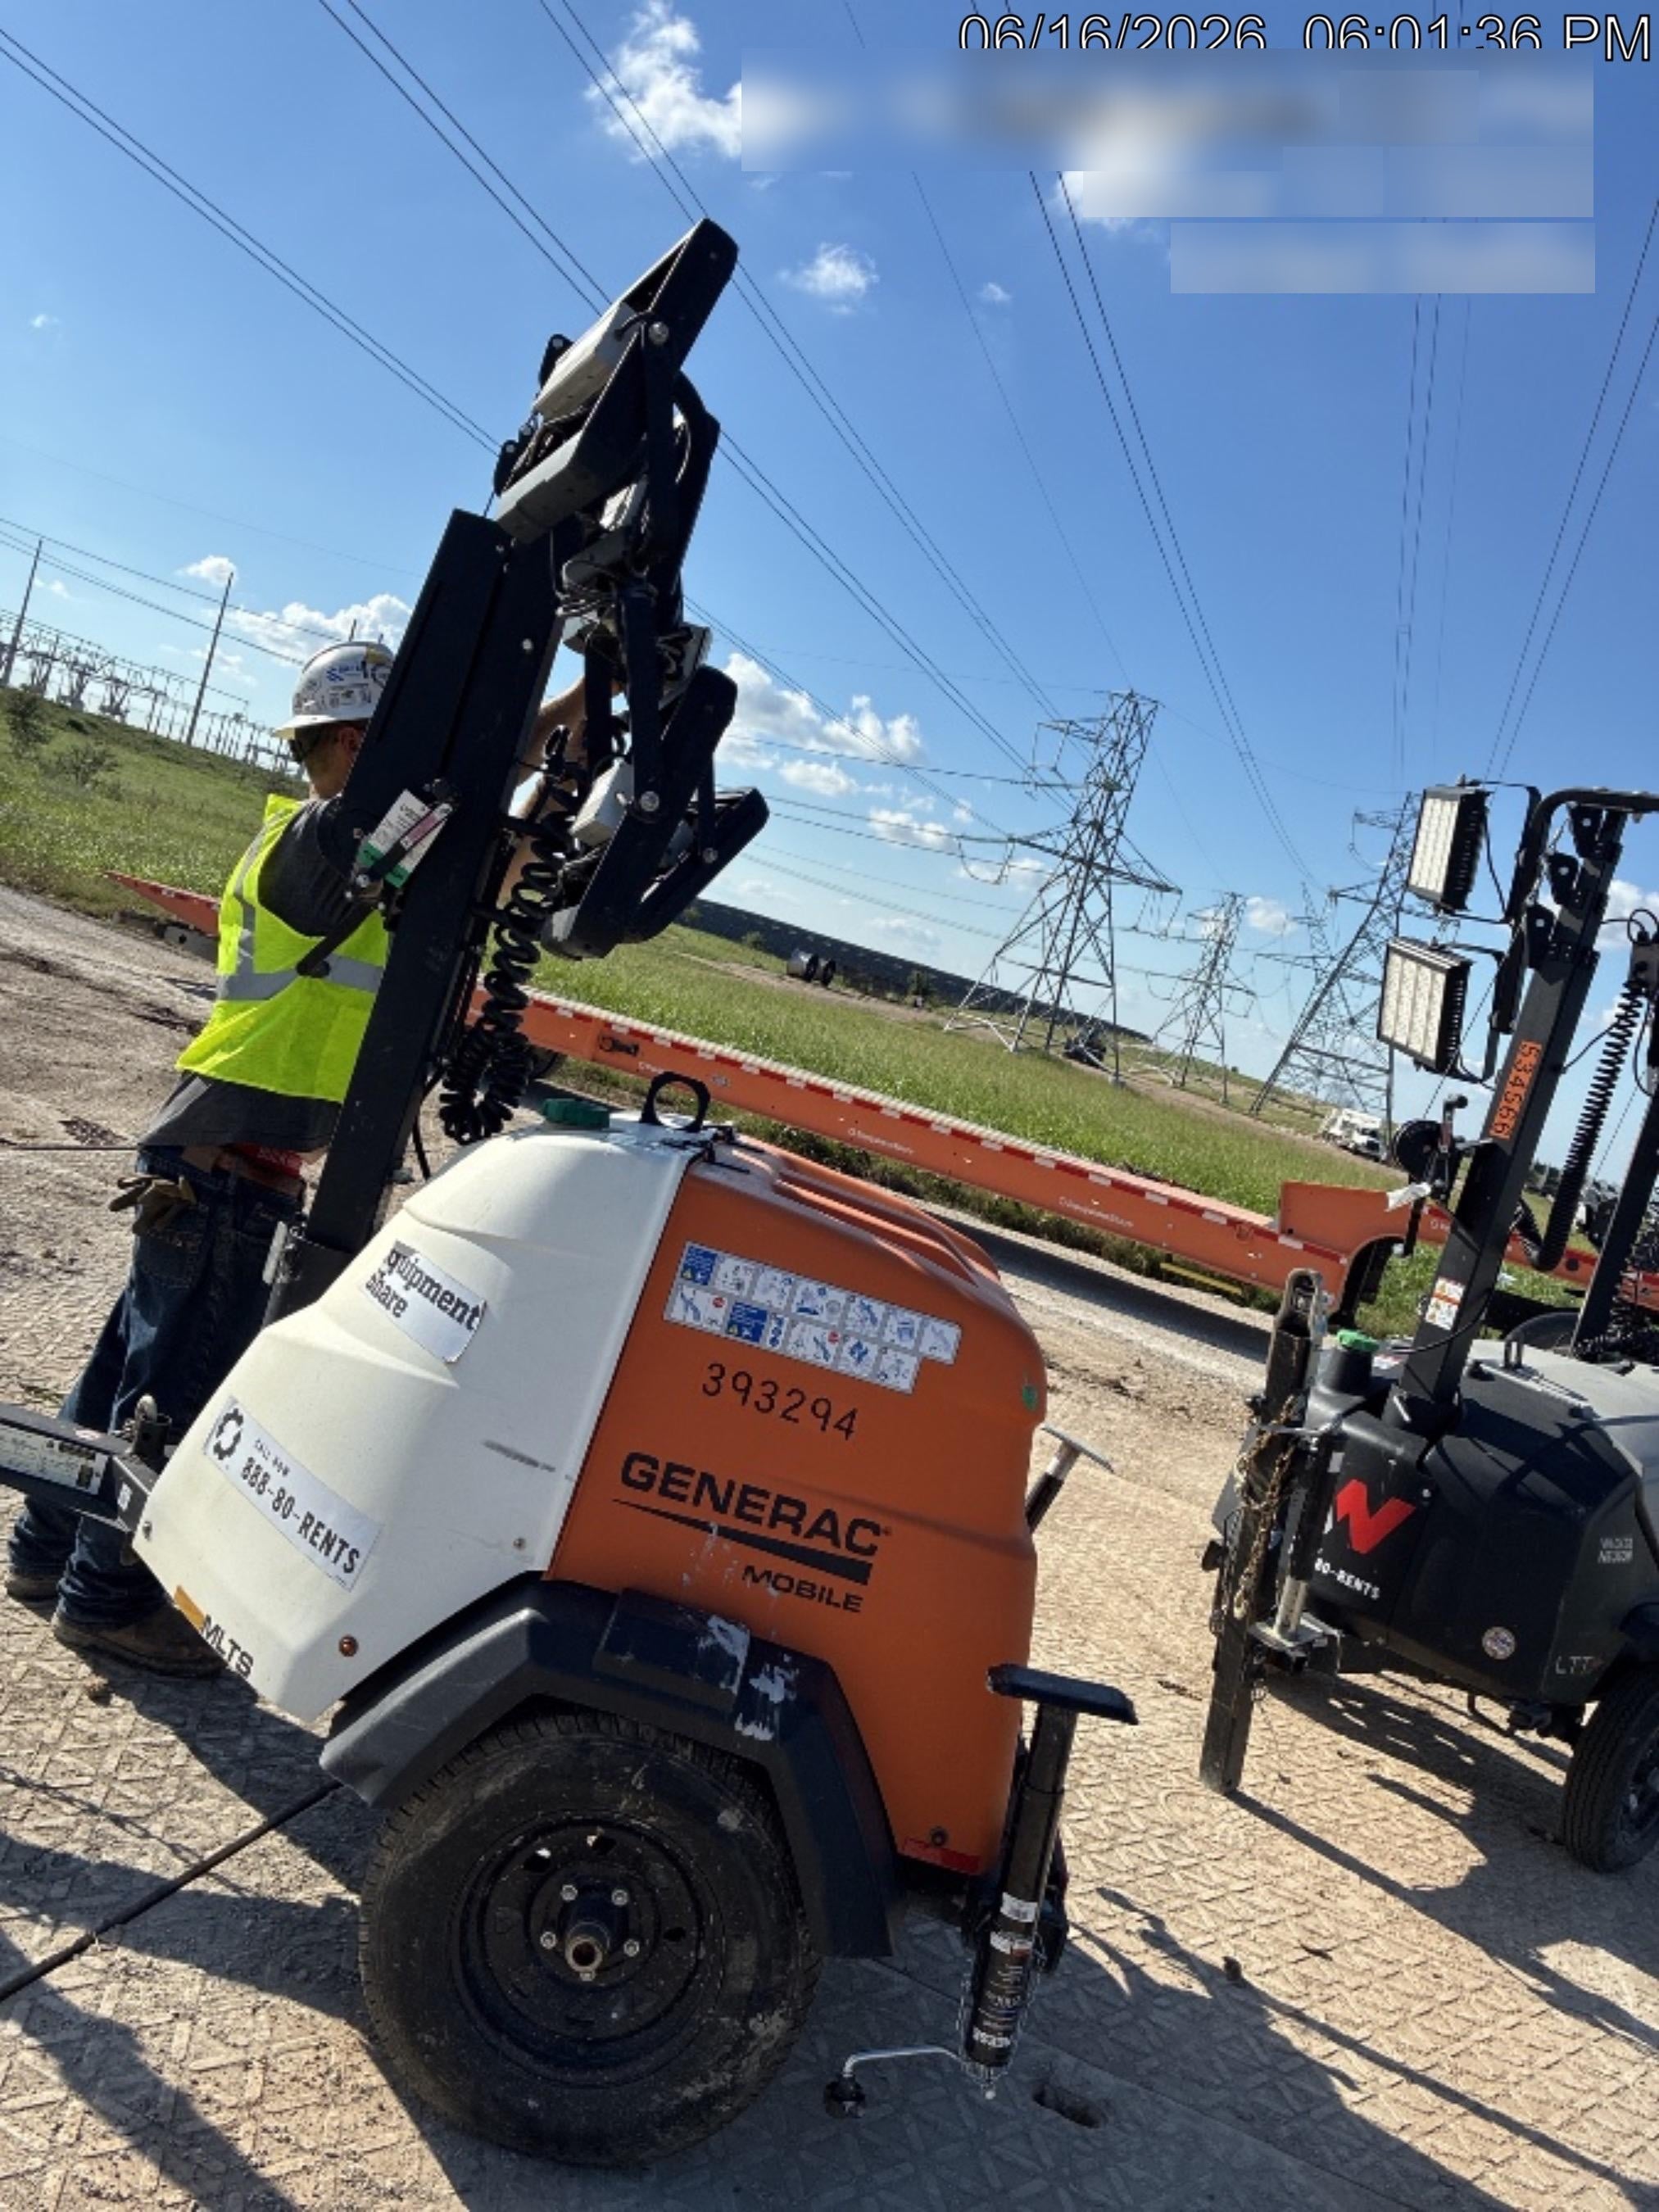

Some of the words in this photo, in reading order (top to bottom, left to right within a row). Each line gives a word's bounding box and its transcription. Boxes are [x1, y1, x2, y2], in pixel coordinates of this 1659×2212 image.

[385, 1249, 482, 1330] quipment
[702, 1363, 859, 1441] 393294
[241, 1457, 360, 1574] 888-80-RENTS
[621, 1452, 882, 1556] GENERAC
[741, 1565, 863, 1612] MOBILE
